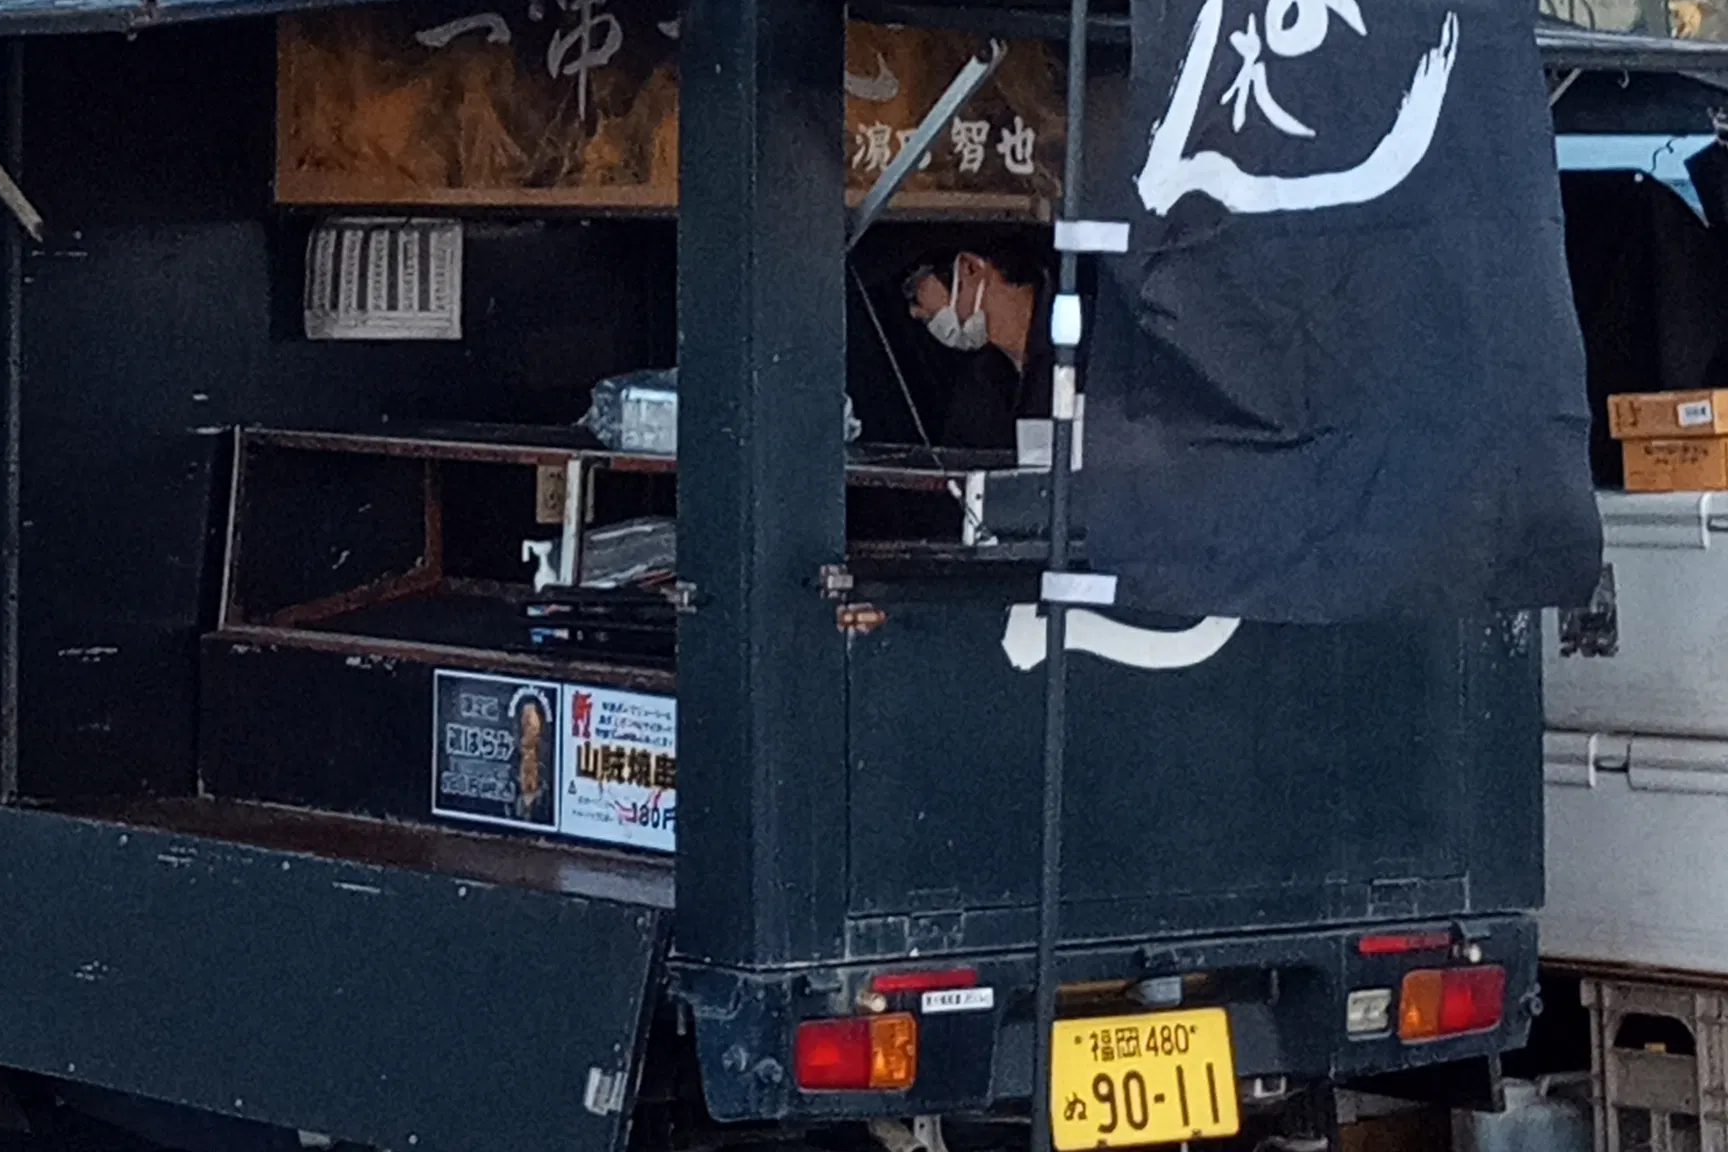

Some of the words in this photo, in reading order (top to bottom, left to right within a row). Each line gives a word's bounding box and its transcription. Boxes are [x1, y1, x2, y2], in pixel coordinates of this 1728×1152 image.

[1090, 1027, 1141, 1062] 福岡
[1145, 1023, 1190, 1057] 480
[1092, 1062, 1220, 1134] 90-11
